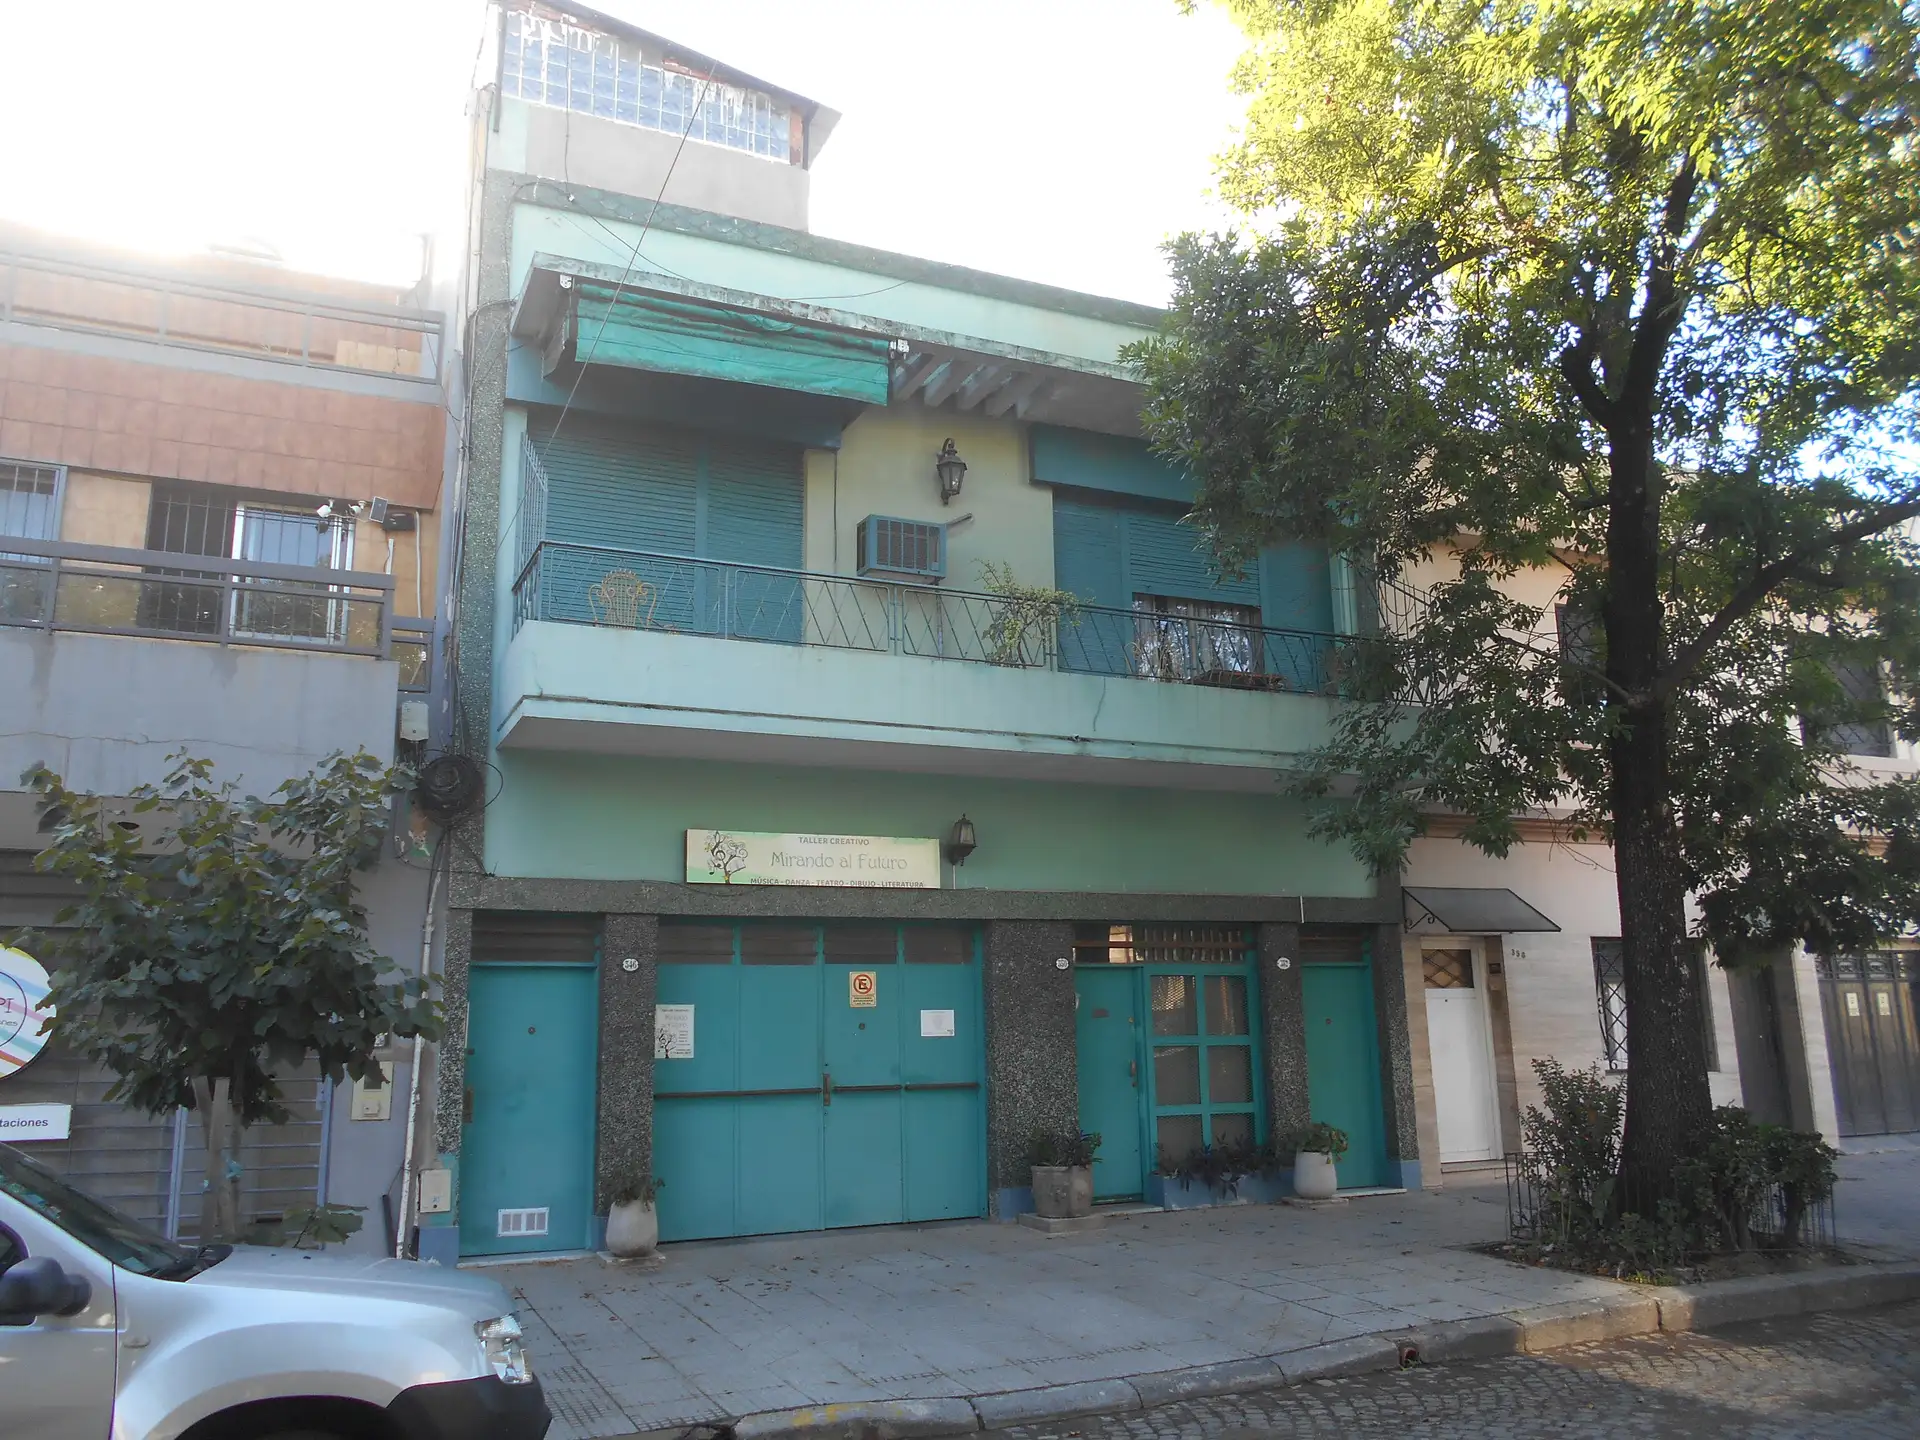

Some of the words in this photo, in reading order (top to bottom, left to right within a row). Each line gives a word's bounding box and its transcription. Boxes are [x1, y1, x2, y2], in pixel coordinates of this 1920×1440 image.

[798, 836, 828, 845] TALLER
[829, 837, 870, 846] CREATIVO
[770, 852, 834, 868] Mirando
[839, 854, 852, 869] al
[858, 853, 908, 870] Futuro
[750, 876, 779, 885] MÚSICA
[785, 878, 810, 886] DANZA
[816, 879, 844, 887] TEATRO
[881, 880, 924, 888] LITERATURA
